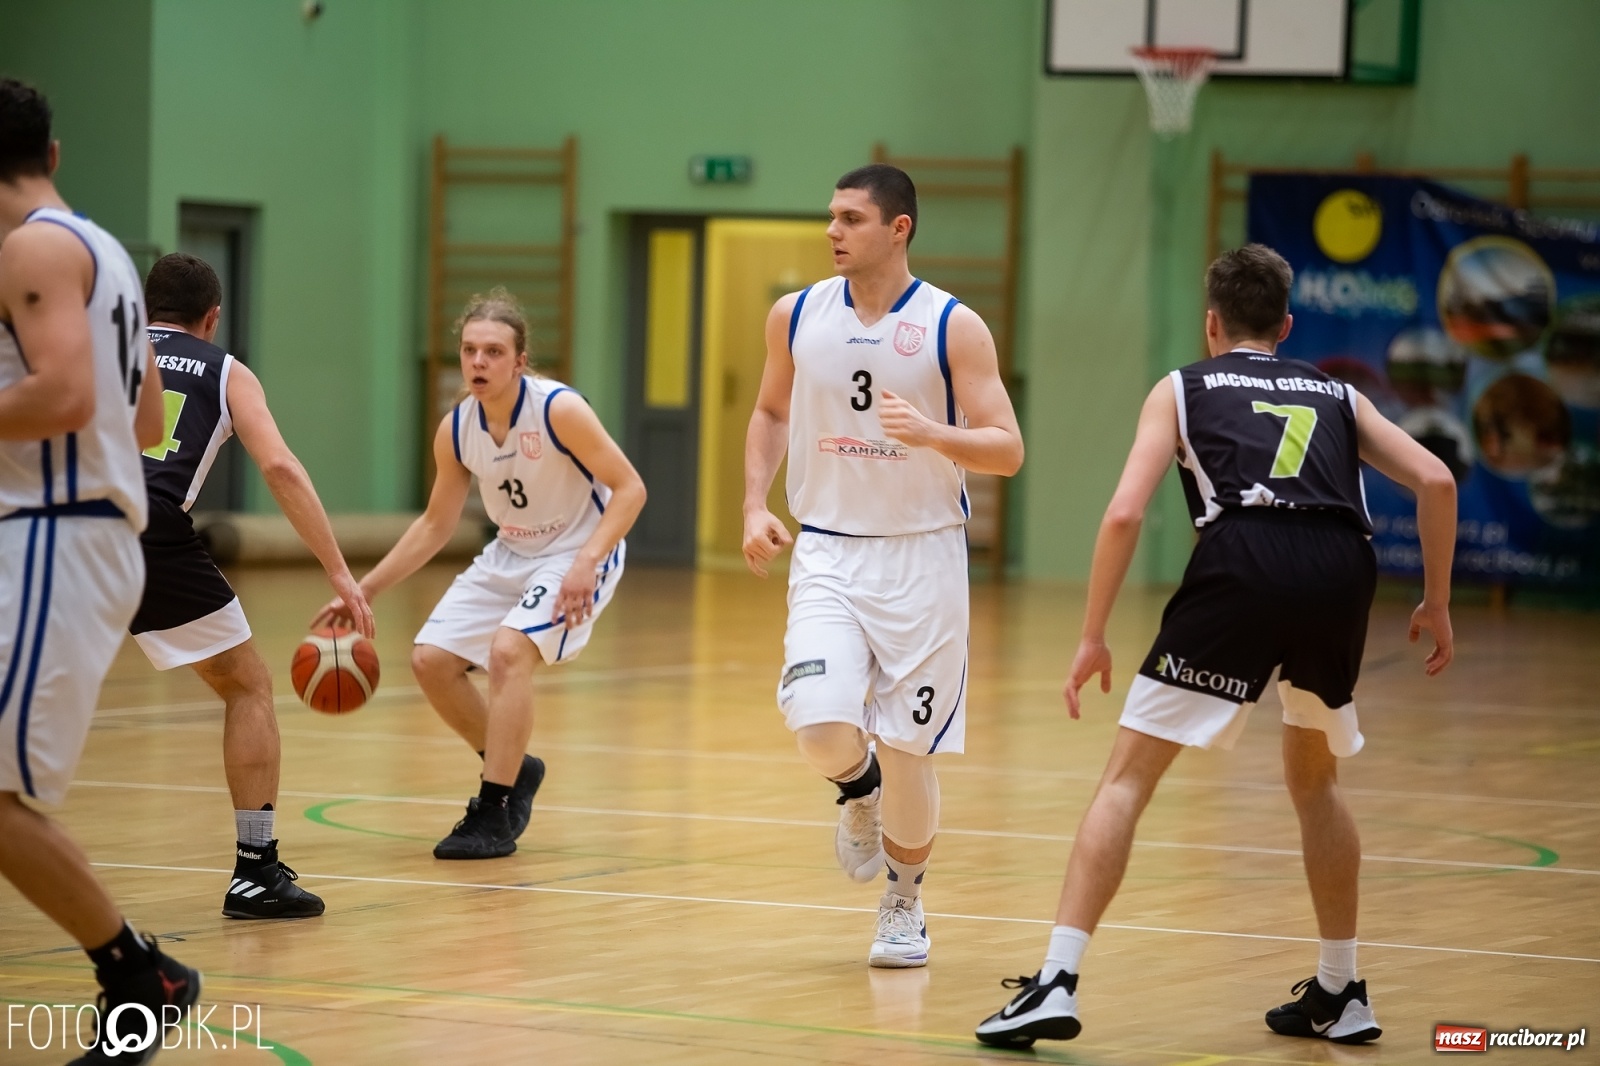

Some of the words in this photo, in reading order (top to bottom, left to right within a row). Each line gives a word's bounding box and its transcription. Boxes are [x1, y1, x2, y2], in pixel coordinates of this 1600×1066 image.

[153, 354, 207, 378] IESZYN
[850, 369, 873, 412] 3
[1203, 372, 1275, 391] NACOMI
[1275, 377, 1345, 401] CIESZYN
[142, 389, 187, 462] 4
[1251, 400, 1318, 479] 7
[838, 444, 898, 458] KAMPKA
[498, 478, 528, 509] 13
[514, 585, 548, 610] 3
[1160, 653, 1249, 699] Nacom
[912, 685, 936, 726] 3
